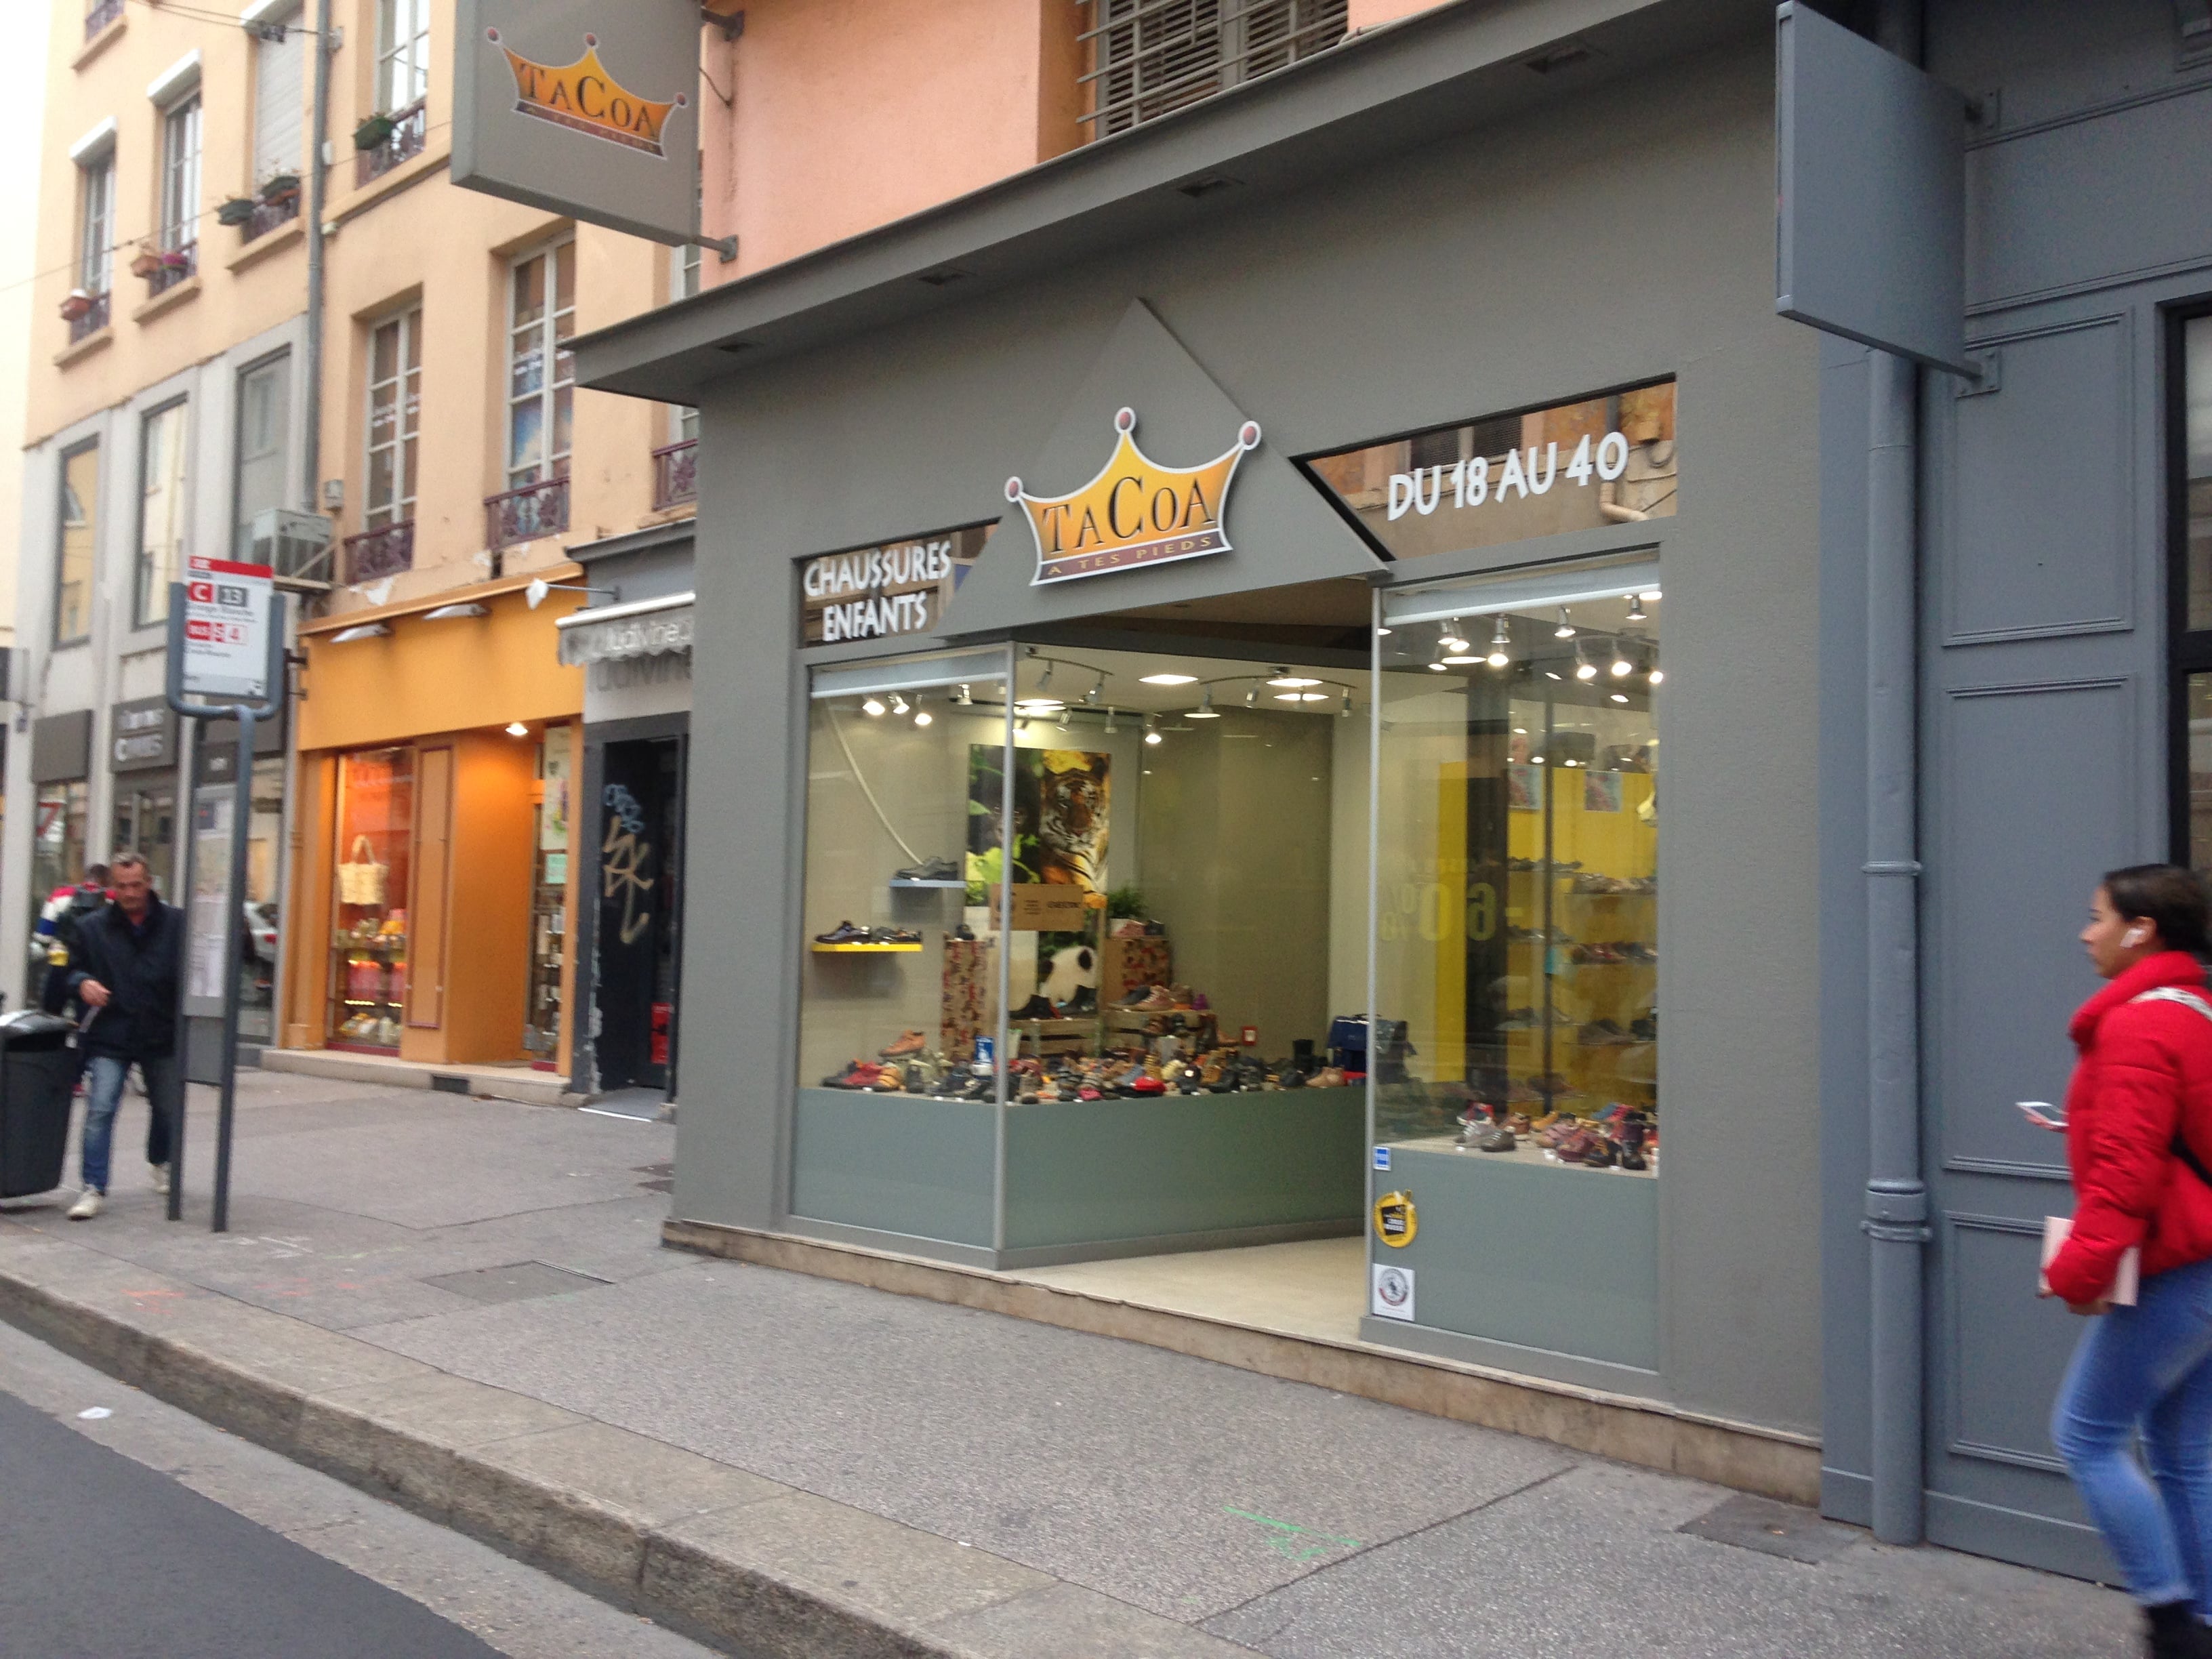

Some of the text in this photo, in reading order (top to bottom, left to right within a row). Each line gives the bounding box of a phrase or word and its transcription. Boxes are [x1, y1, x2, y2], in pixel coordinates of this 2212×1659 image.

[1387, 432, 1628, 520] DU 18 AU 40
[803, 540, 951, 596] CHAUSSURES
[1047, 535, 1212, 576] A TES PIEDS
[822, 591, 927, 641] ENFANTS
